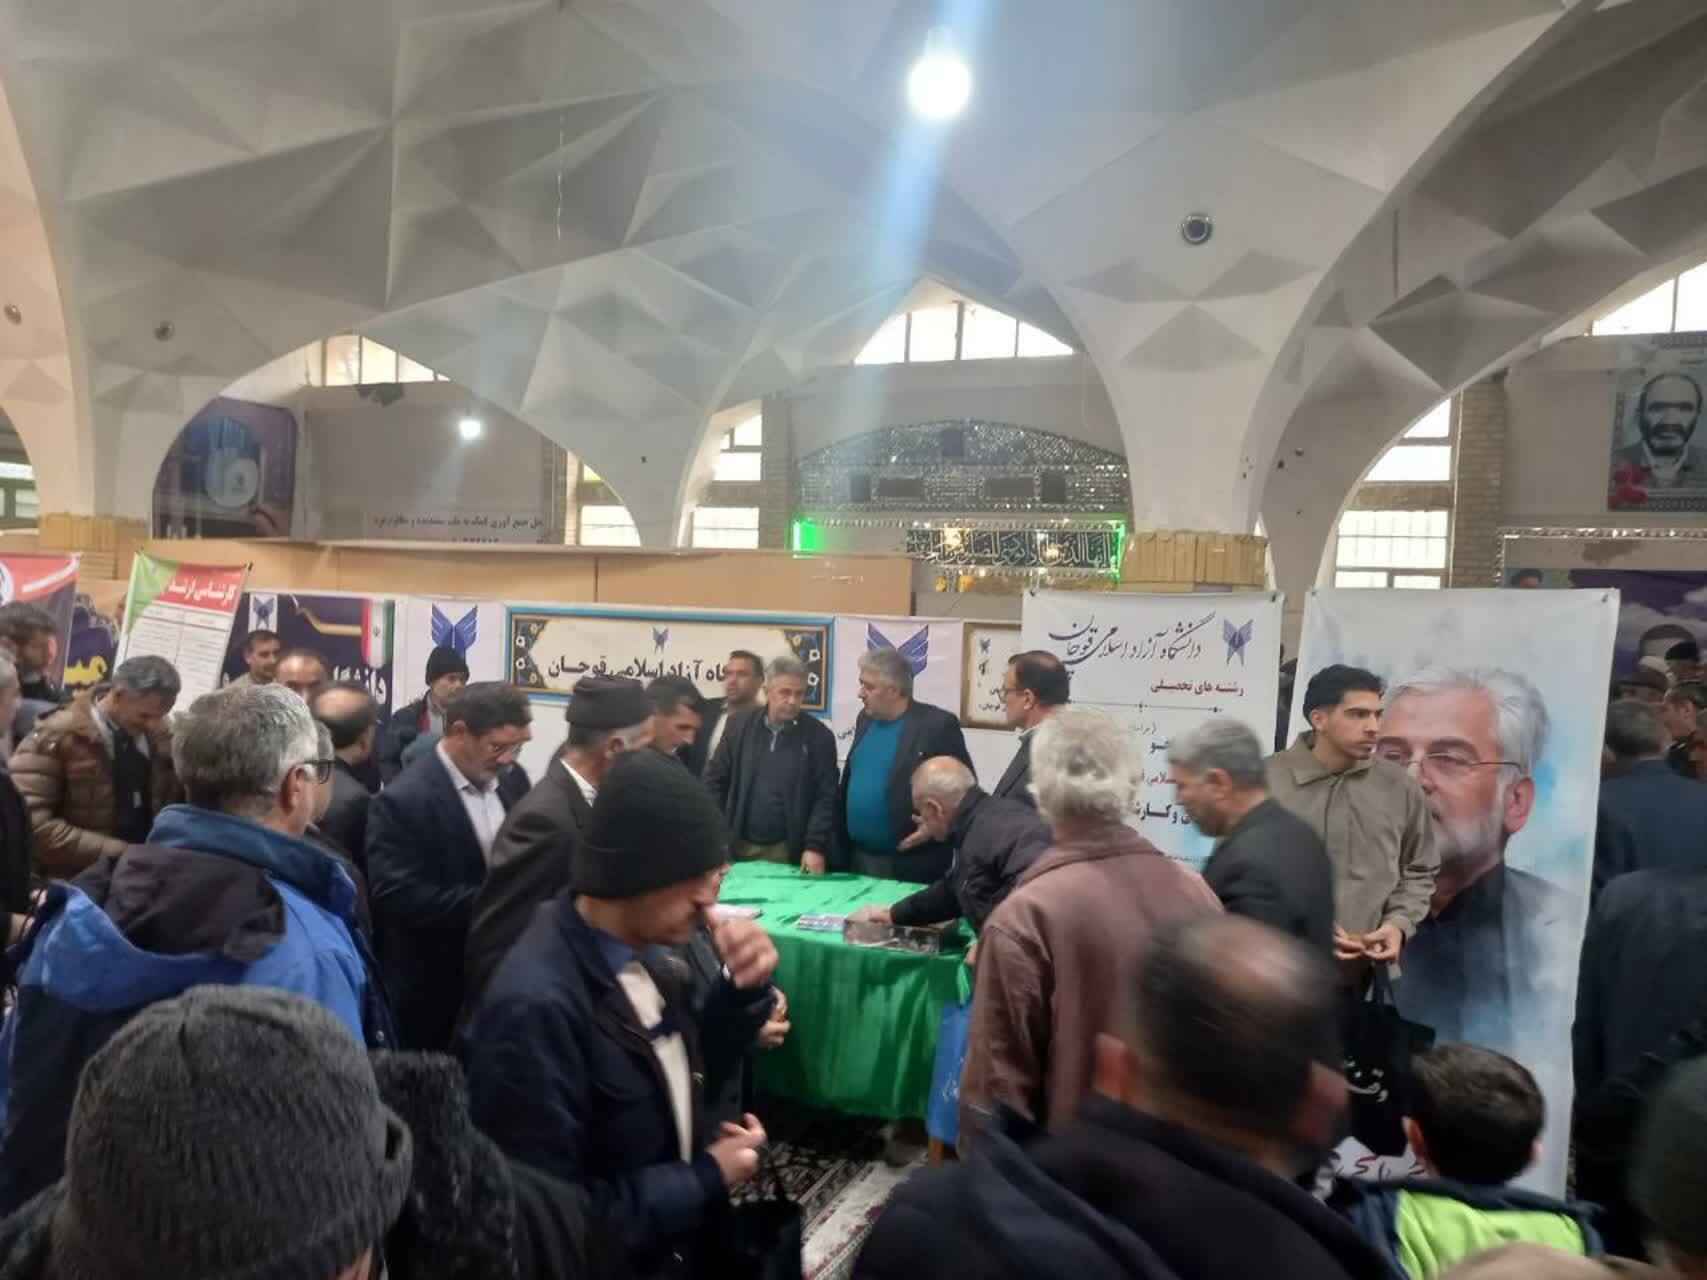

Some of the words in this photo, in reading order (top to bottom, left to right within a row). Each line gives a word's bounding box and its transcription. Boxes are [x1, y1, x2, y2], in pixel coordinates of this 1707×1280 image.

[1062, 626, 1129, 666] اسلامی
[1129, 628, 1169, 660] آزاد
[1159, 608, 1216, 660] دانشگاه
[1150, 678, 1193, 693] تحصیلی
[1194, 679, 1213, 696] های
[1215, 680, 1244, 697] رشته
